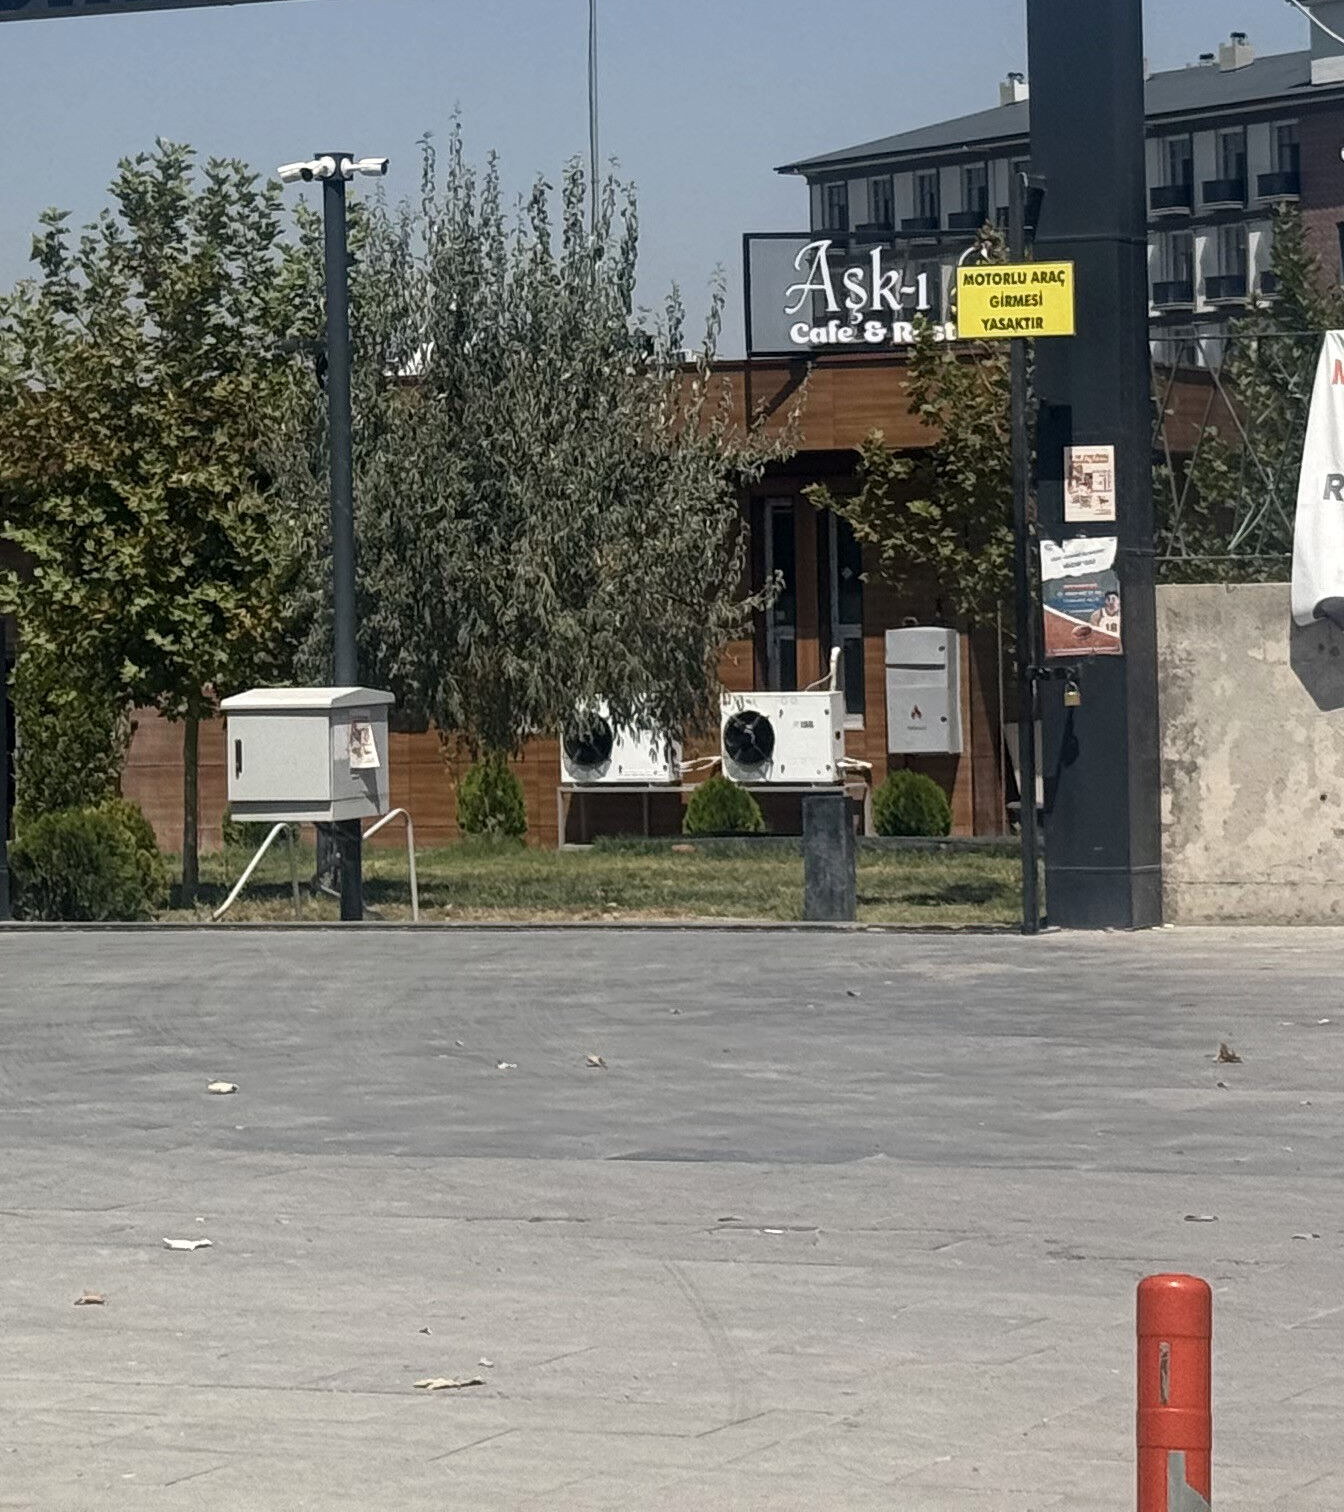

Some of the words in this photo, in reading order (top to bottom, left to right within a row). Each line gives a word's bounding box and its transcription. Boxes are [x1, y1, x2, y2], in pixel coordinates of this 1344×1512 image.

[963, 272, 1027, 286] MOTORLU
[1031, 270, 1065, 287] ARAÇ
[989, 290, 1043, 308] GİRMESİ
[790, 320, 854, 344] Cafe
[864, 320, 887, 343] &
[892, 321, 957, 344] Rst
[981, 317, 1044, 332] YASAKTIR
